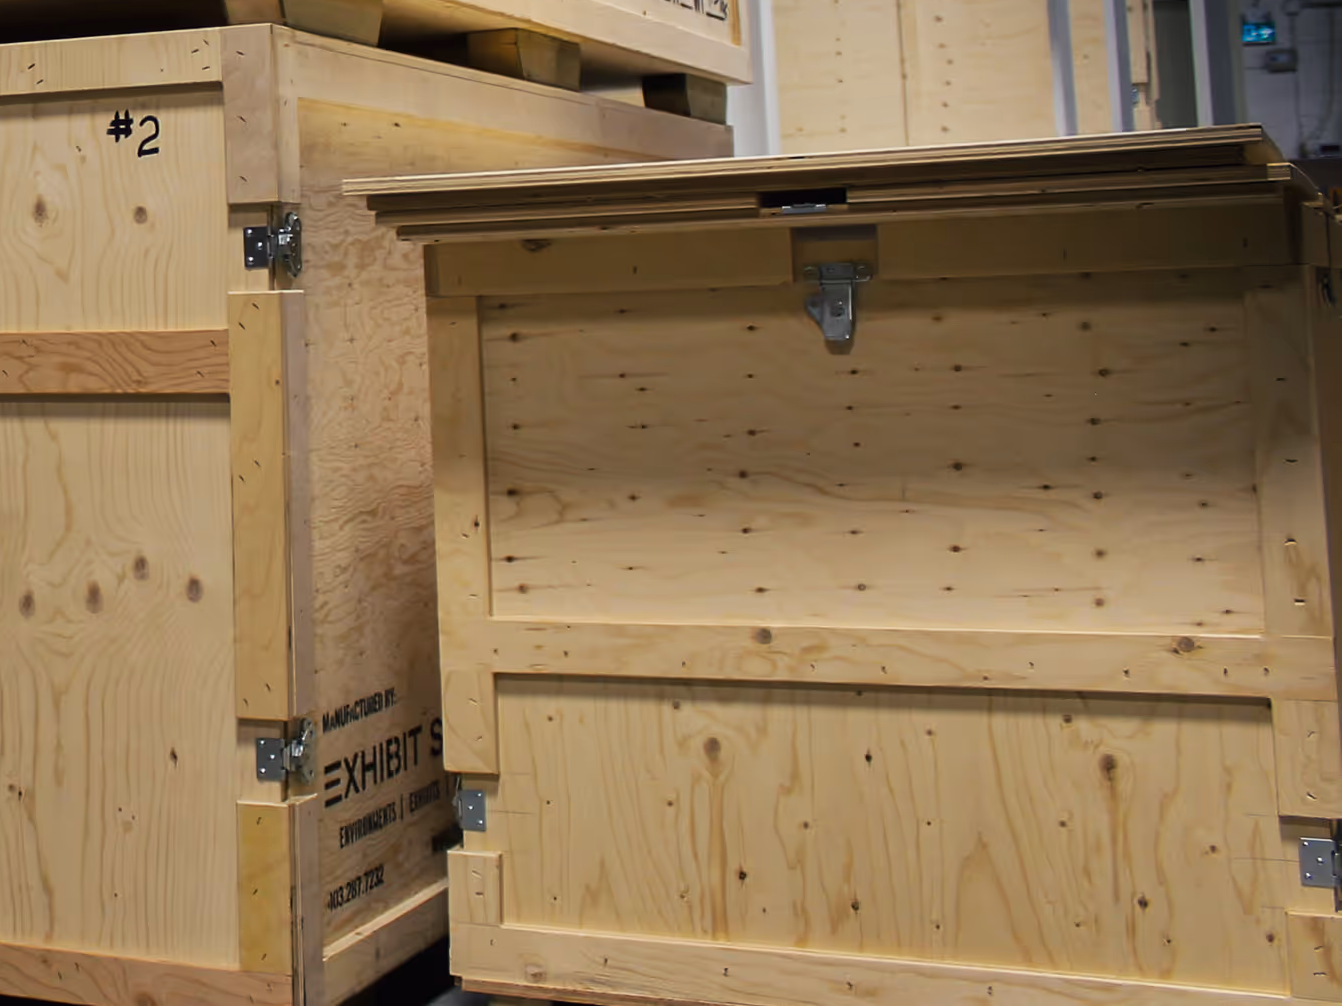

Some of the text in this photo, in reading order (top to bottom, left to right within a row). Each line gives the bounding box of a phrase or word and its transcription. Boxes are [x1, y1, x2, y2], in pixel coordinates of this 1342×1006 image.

[106, 108, 160, 158] #2
[324, 725, 423, 808] EXHIBIT
[339, 801, 397, 849] ENVIRONMENTS
